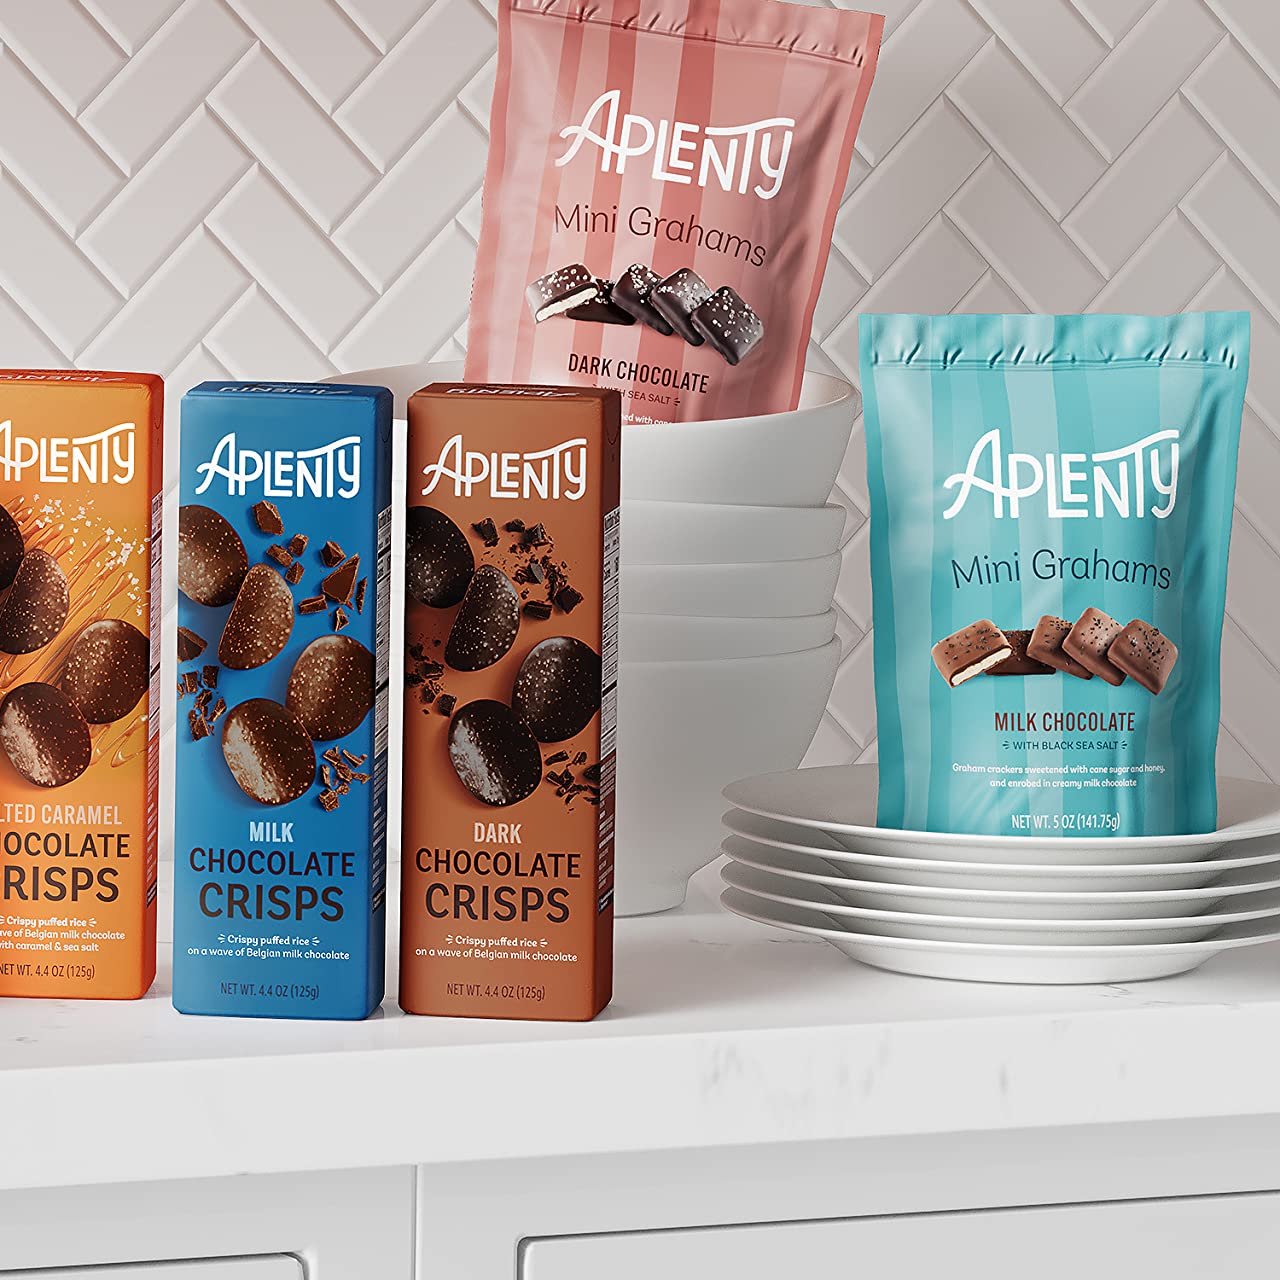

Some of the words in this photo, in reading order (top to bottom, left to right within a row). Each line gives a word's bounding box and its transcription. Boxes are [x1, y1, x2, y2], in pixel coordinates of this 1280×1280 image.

[554, 89, 795, 200] APLENTY
[555, 204, 617, 233] Mini
[629, 207, 765, 266] Grahams
[568, 353, 611, 377] DARK
[616, 360, 709, 394] CHOCOLATE
[628, 390, 646, 402] SEA
[648, 394, 671, 404] SALT
[196, 433, 360, 498] APLENTY
[422, 435, 586, 500] APLENTY
[943, 429, 1180, 519] APLENTY
[952, 552, 1020, 588] Mini
[1033, 549, 1170, 589] Grahams
[995, 713, 1036, 731] MILK
[1043, 712, 1135, 731] CHOCOLATE
[1042, 741, 1072, 750] BLACK
[1075, 741, 1094, 750] SEA
[1097, 741, 1118, 750] SALT
[42, 804, 122, 824] CARAMEL
[250, 822, 293, 842] MILK
[475, 823, 521, 843] DARK
[190, 848, 354, 876] CHOCOLATE
[416, 848, 580, 877] CHOCOLATE
[200, 882, 343, 921] CRISPS
[426, 882, 569, 923] CRISPS
[15, 942, 51, 951] caramel
[53, 942, 61, 951] &
[64, 943, 78, 952] sea
[80, 943, 99, 951] salt
[228, 935, 258, 946] Crispy
[261, 936, 290, 946] puffed
[292, 937, 309, 945] rice
[447, 983, 463, 996] NET
[465, 984, 482, 996] WT.
[485, 986, 499, 997] 4.4
[501, 984, 517, 998] OZ
[517, 985, 545, 1001] (125g)
